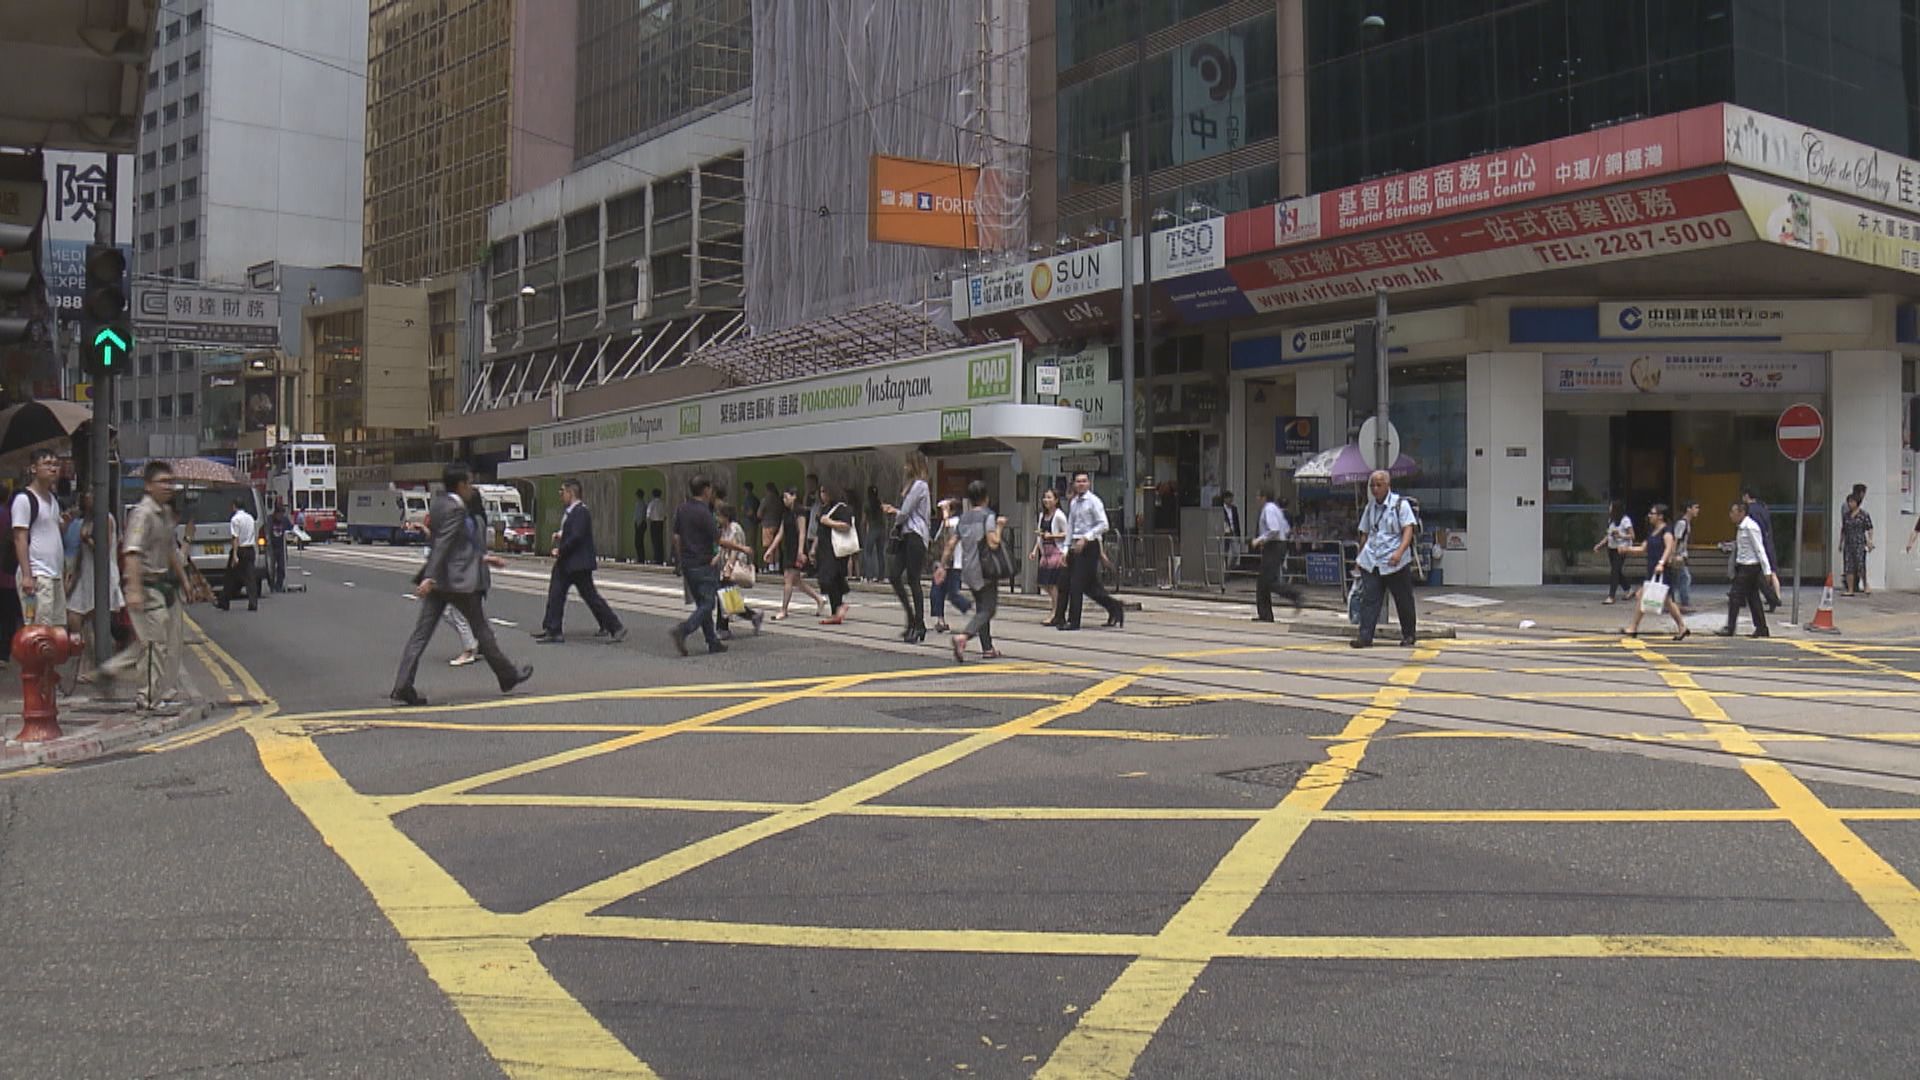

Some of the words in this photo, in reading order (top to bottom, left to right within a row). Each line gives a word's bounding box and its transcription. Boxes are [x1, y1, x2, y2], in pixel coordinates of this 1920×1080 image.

[1338, 152, 1536, 216] 基智策略商務中心
[1839, 161, 1852, 180] de
[1339, 211, 1383, 230] Superior
[1386, 201, 1433, 220] Strategy
[1436, 189, 1489, 209] Business
[1493, 180, 1535, 198] Centre
[1165, 224, 1213, 261] TSO
[1533, 243, 1590, 264] TEL:
[1594, 217, 1732, 256] 2287-5000
[1057, 252, 1100, 282] SUN
[1057, 278, 1100, 295] MOBILE
[1257, 264, 1444, 308] www.virtual.com.hk
[972, 358, 1008, 385] POAD
[800, 384, 863, 413] POADGROUP
[865, 374, 933, 411] Instagram
[1074, 397, 1103, 413] SUN
[943, 411, 969, 432] POAD
[1094, 432, 1112, 441] SUN
